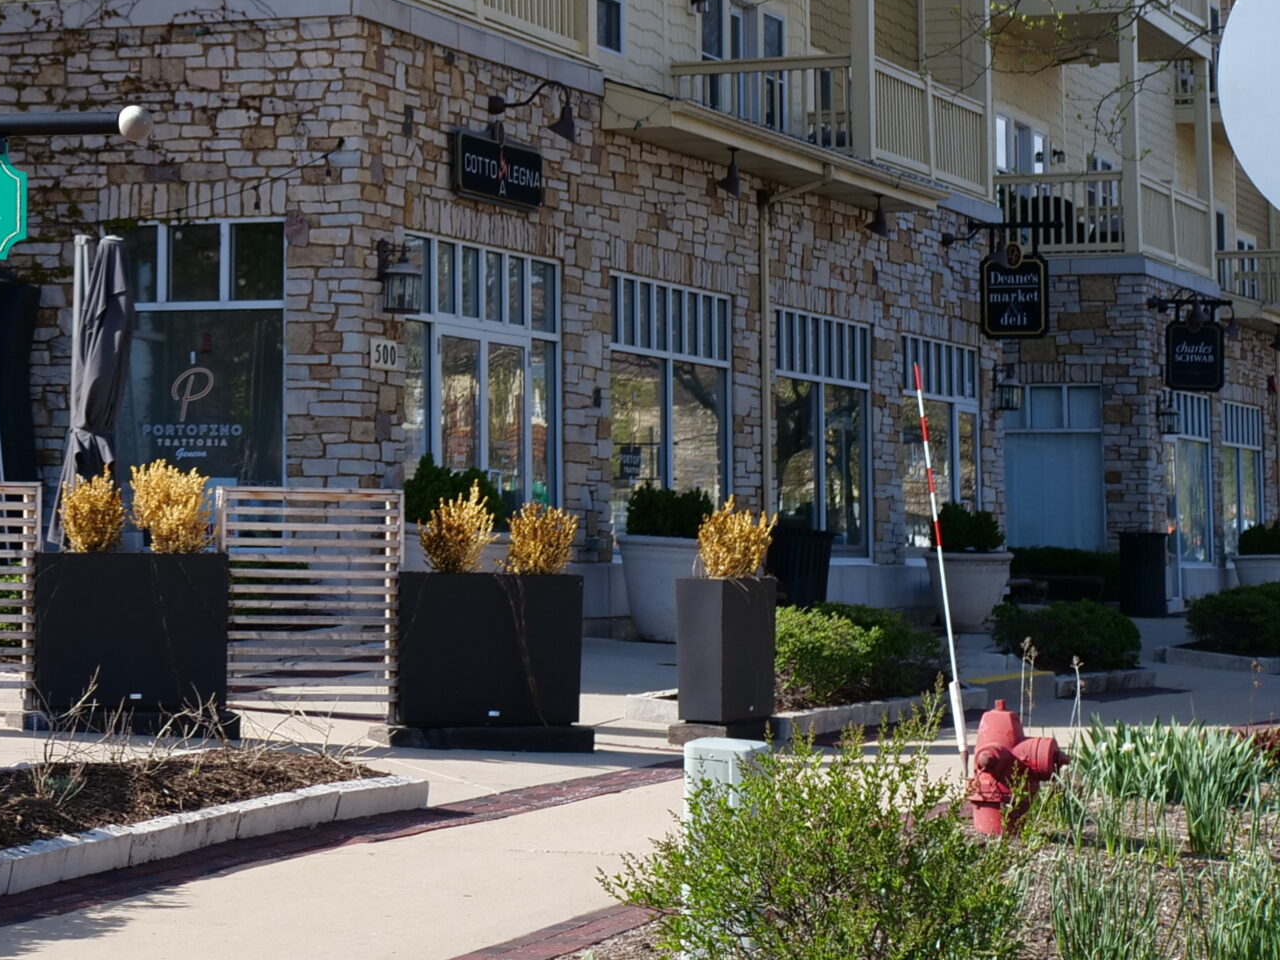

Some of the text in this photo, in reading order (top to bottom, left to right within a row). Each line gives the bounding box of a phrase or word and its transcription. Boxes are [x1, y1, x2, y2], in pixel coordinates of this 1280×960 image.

[464, 152, 540, 190] COTTO LEGNA
[989, 271, 1039, 285] Deane's
[989, 289, 1039, 302] market
[1000, 312, 1028, 326] deli
[374, 342, 397, 367] 500
[1175, 341, 1214, 354] charles
[171, 367, 215, 423] P
[142, 424, 243, 437] PORTOFINO
[156, 438, 228, 447] TRATTORIA
